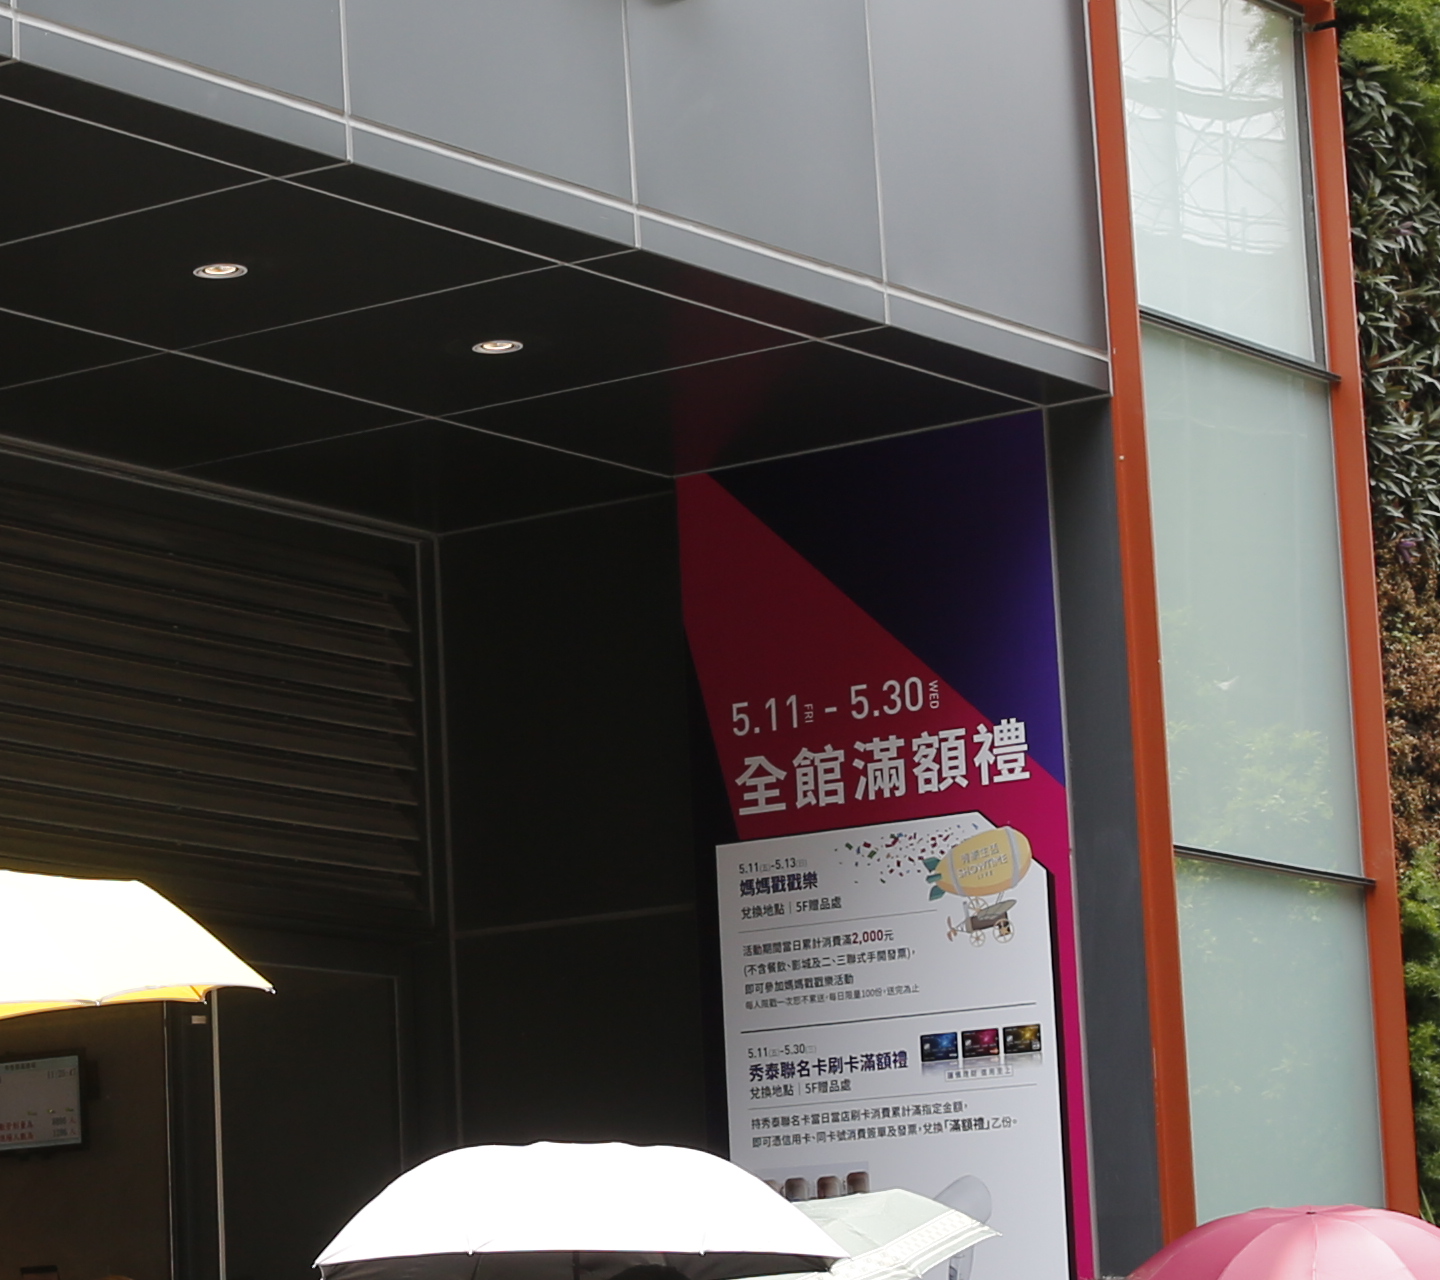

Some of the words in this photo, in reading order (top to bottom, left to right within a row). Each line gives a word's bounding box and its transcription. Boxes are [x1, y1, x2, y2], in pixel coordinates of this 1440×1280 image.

[731, 694, 799, 737] 5.11
[804, 704, 814, 724] FRI
[849, 676, 924, 720] 5.30
[928, 680, 940, 710] WED
[734, 717, 1031, 816] 全館滿額禮
[740, 871, 818, 897] 媽媽戳戳樂
[749, 1050, 909, 1082] 秀泰聯名卡刷卡滿額禮
